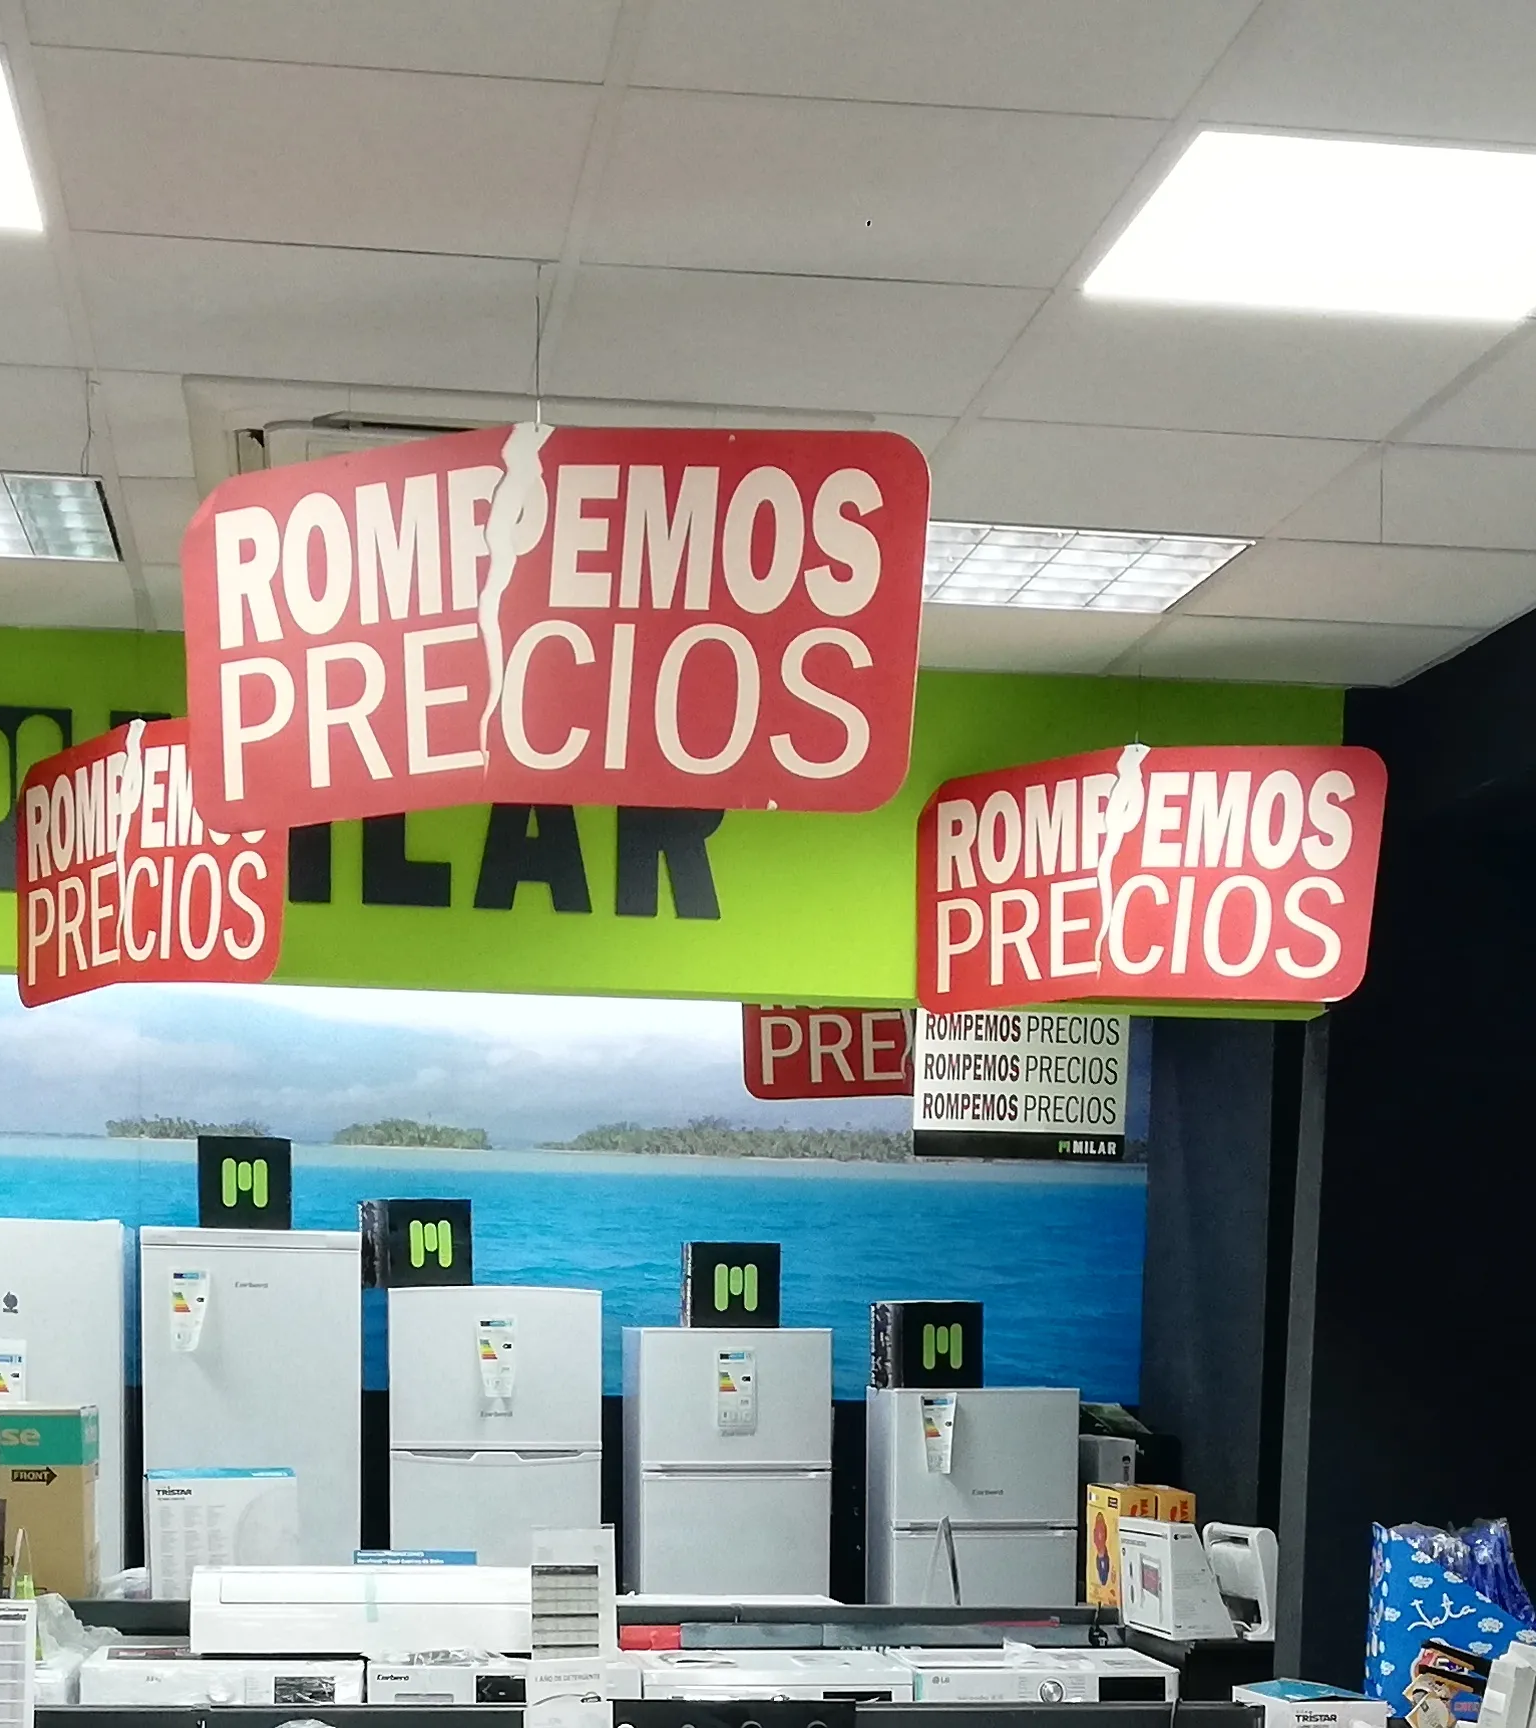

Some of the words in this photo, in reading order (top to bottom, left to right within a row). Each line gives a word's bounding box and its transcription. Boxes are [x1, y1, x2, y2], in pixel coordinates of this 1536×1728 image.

[214, 464, 884, 650] ROMPEMOS
[219, 620, 873, 801] PRECIOS
[25, 744, 266, 883] ROMPEM
[937, 770, 1355, 893] ROMPEMOS
[27, 852, 266, 987] PRECIOS
[937, 873, 1345, 994] PRECIOS
[762, 1015, 904, 1084] PRE
[925, 1014, 1021, 1043] ROMPEMOS
[1027, 1017, 1121, 1046] PRECIOS
[923, 1053, 1020, 1082] ROMPEMOS
[1025, 1056, 1118, 1086] PRECIOS
[922, 1093, 1018, 1121] ROMPEMOS
[1023, 1095, 1116, 1125] PRECIOS
[1072, 1141, 1116, 1156] MILAR
[13, 1471, 50, 1481] FRONT
[1407, 1591, 1477, 1632] Jata
